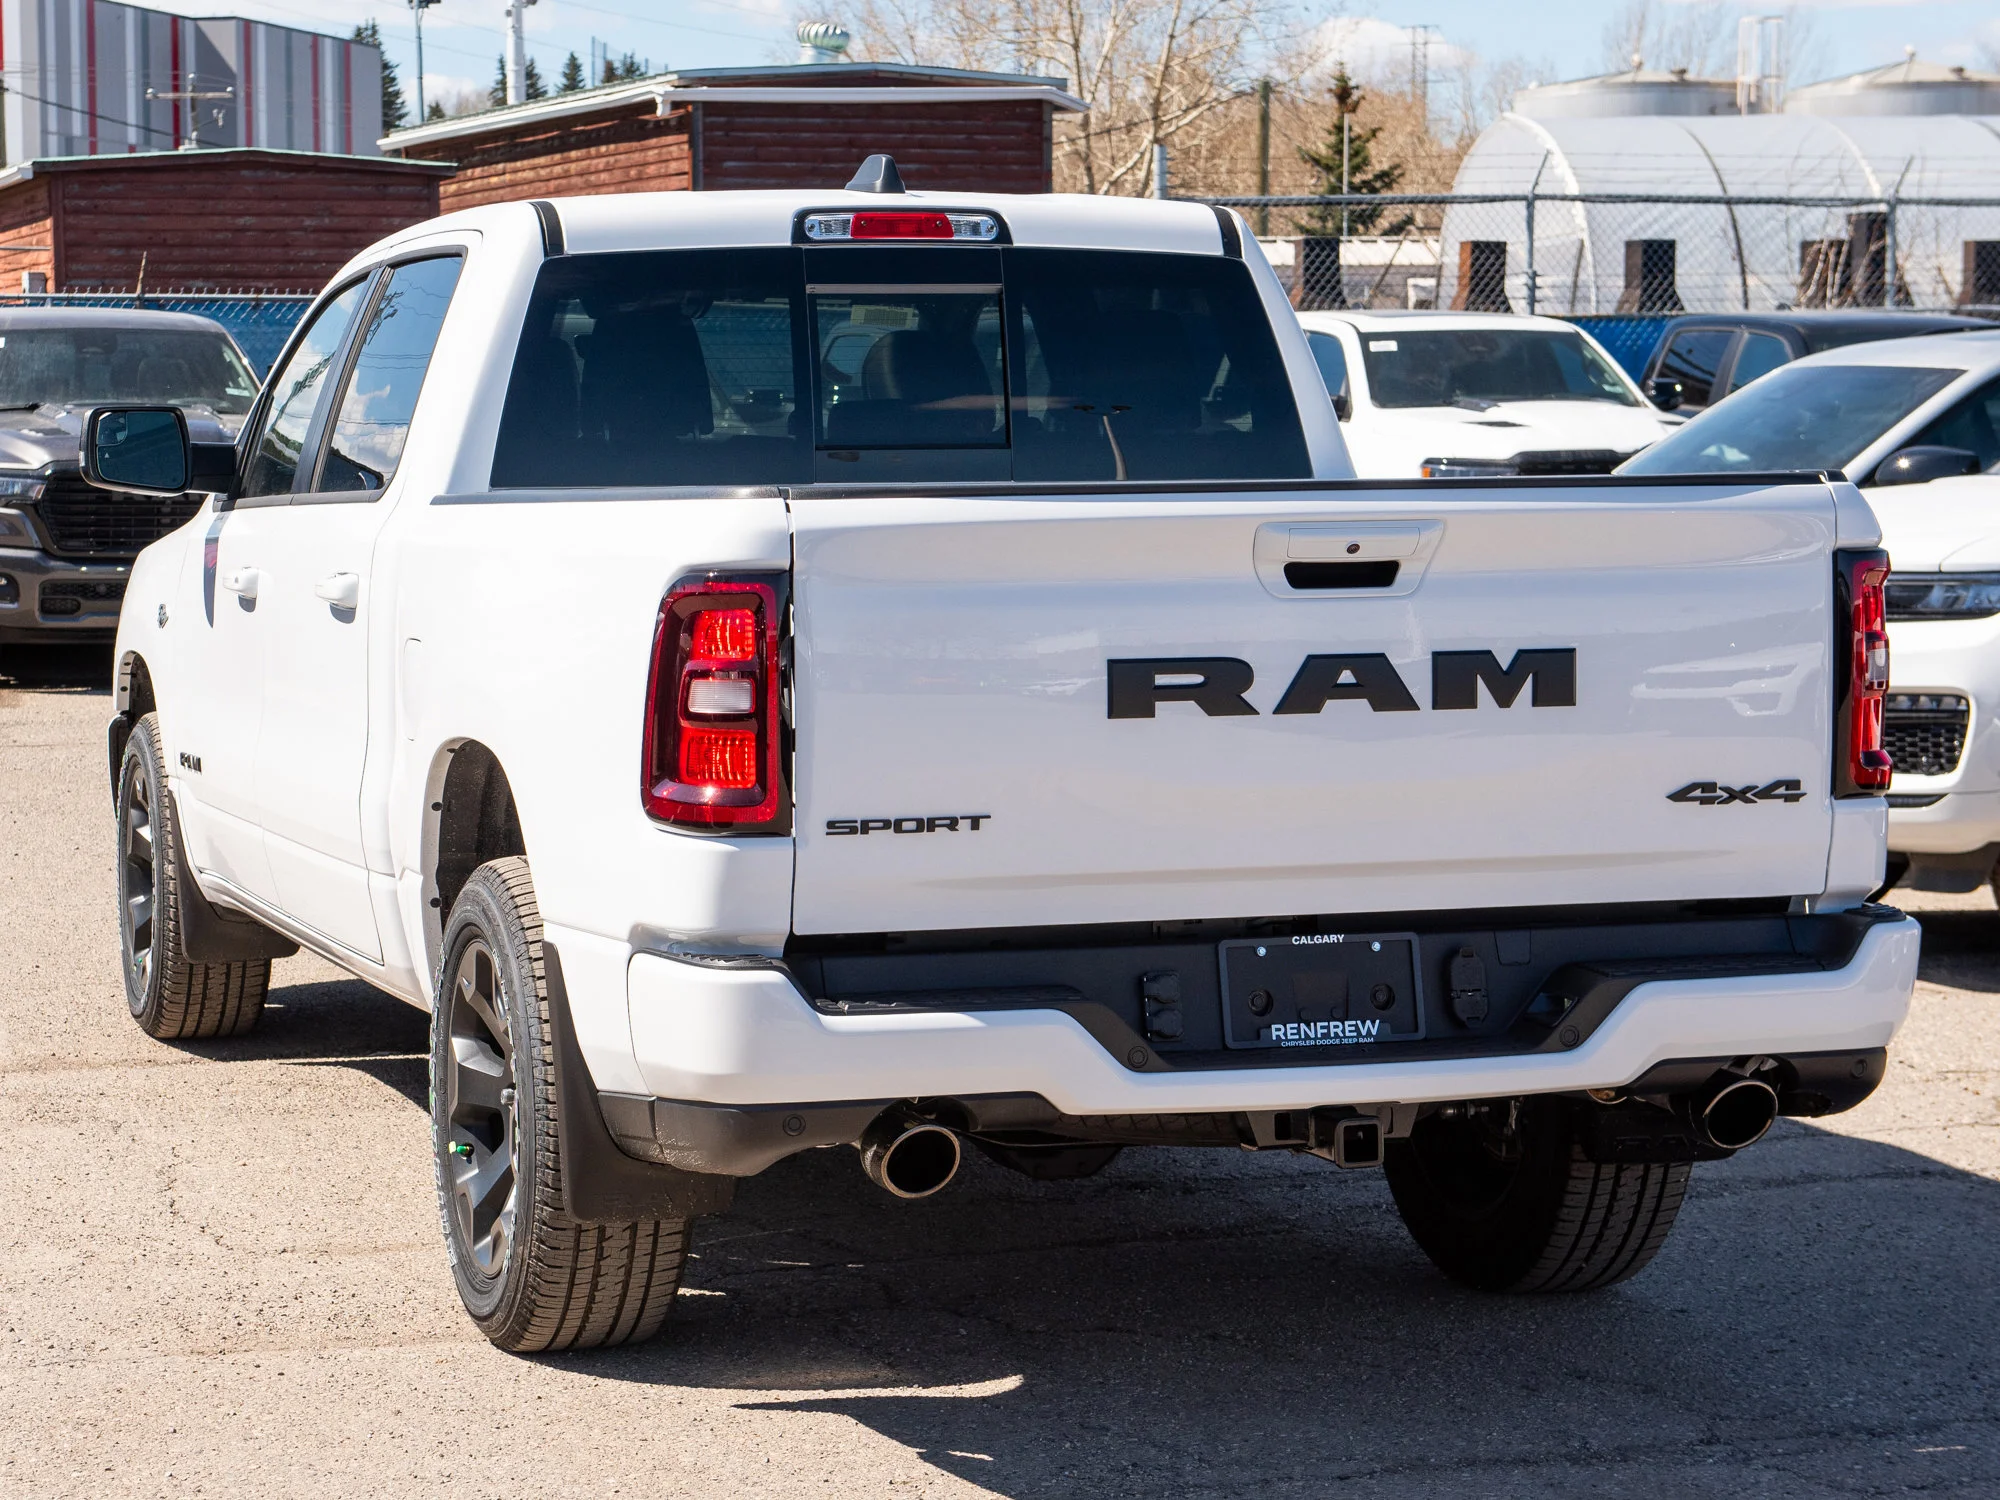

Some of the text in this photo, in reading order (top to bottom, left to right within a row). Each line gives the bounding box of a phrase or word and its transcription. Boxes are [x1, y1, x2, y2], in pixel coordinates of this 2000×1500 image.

[1107, 648, 1577, 719] RAM
[1665, 779, 1808, 806] 4x4
[825, 814, 992, 836] SPORT
[1291, 934, 1345, 945] CALGARY
[1271, 1019, 1380, 1041] RENFREW
[1316, 1038, 1341, 1046] DODGE
